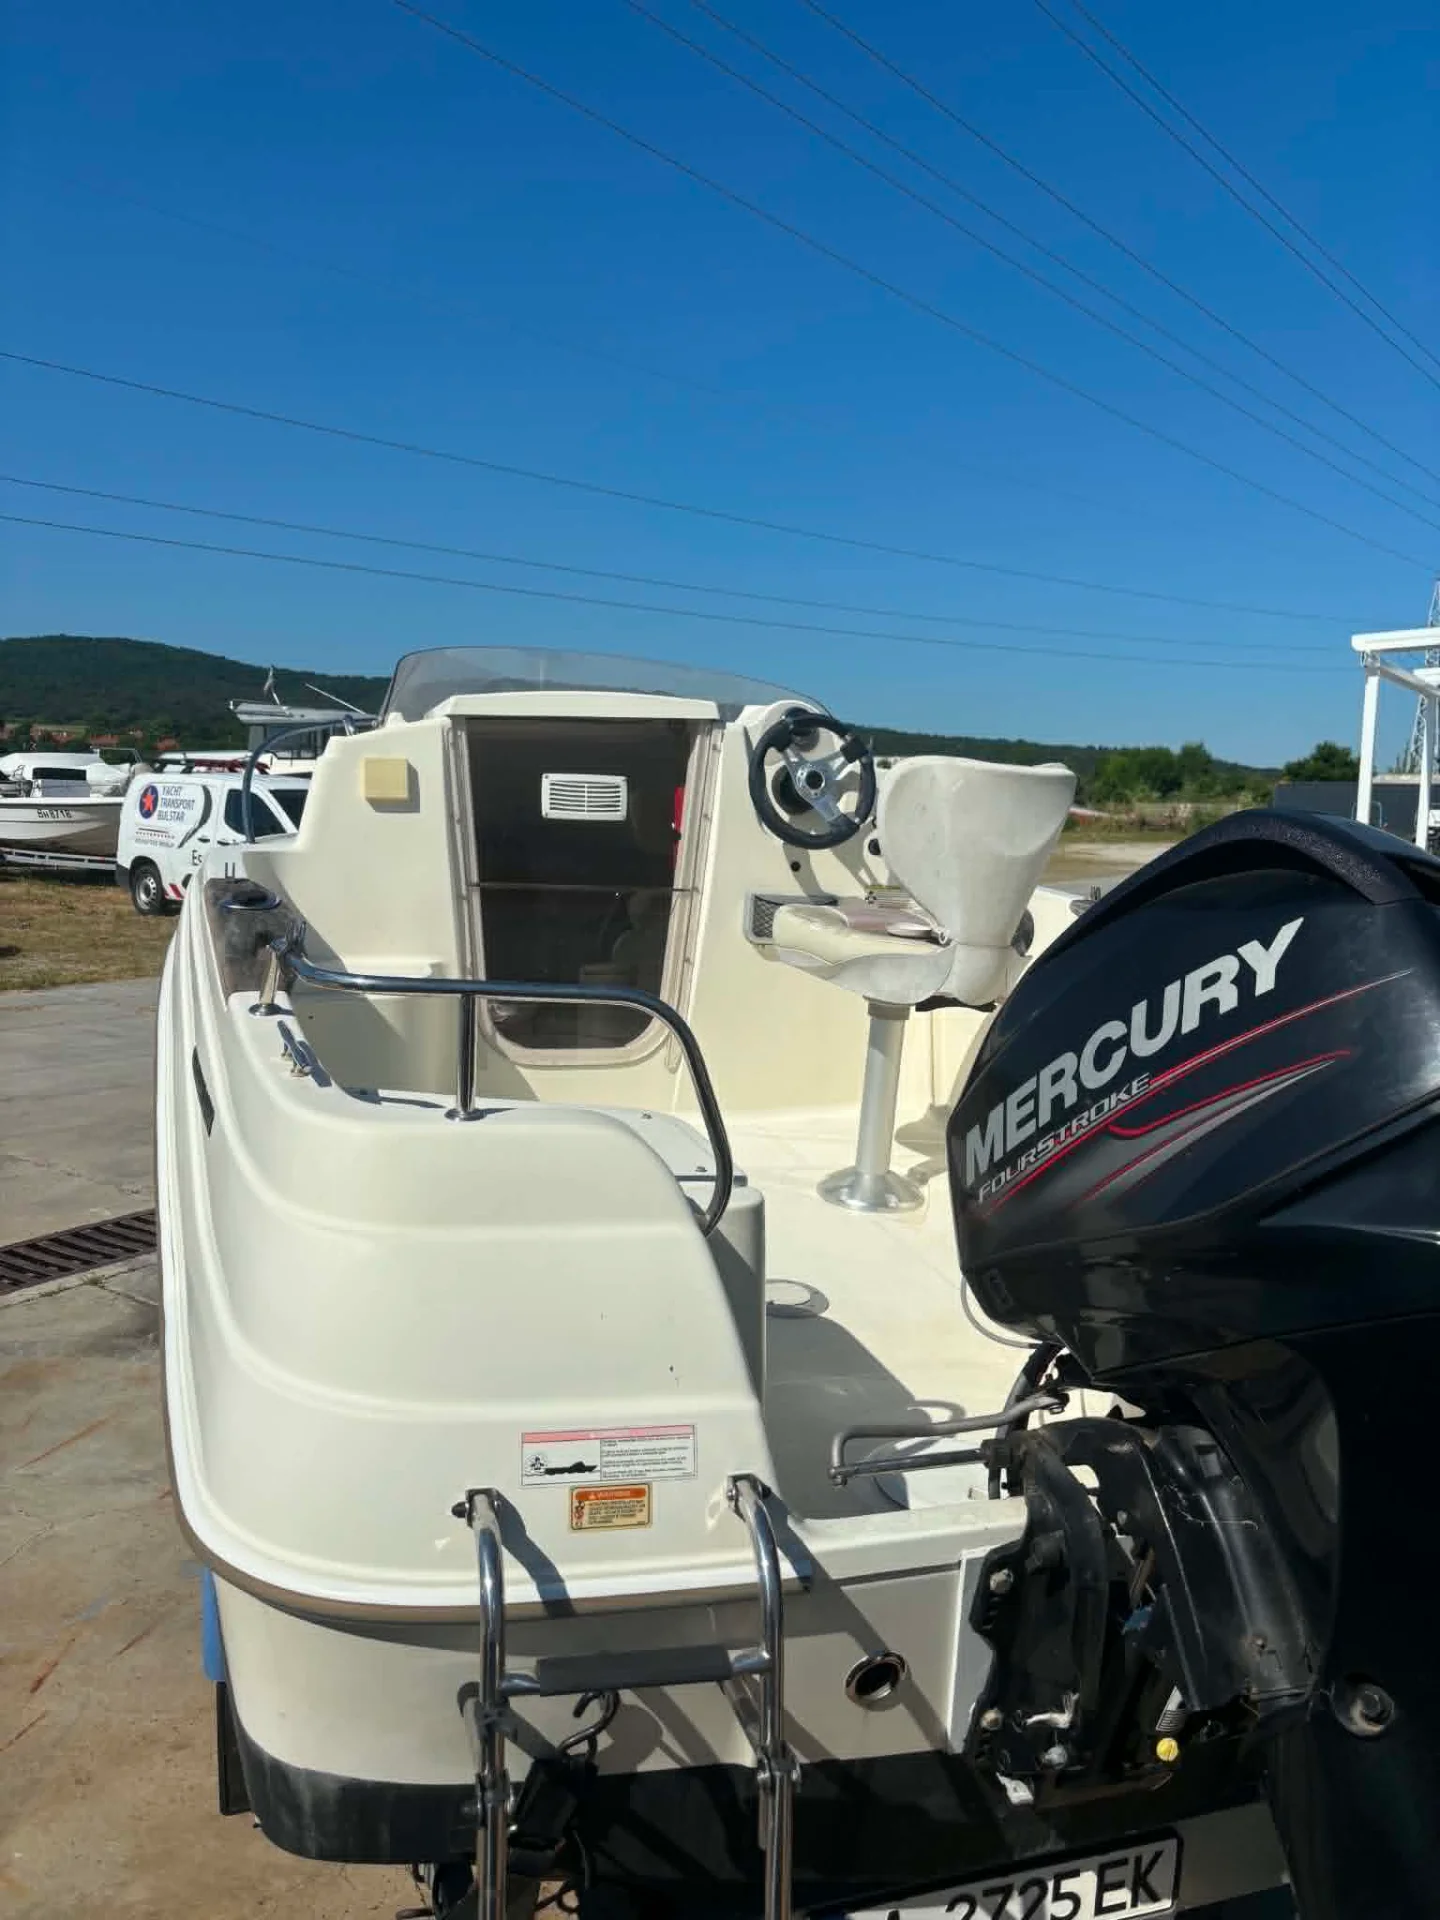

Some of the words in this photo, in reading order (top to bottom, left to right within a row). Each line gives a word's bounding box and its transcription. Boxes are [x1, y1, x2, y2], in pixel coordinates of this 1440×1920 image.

[160, 797, 195, 810] TRANSPORT
[965, 917, 1304, 1187] MERCURY
[978, 1072, 1152, 1202] FOURSTROKE
[1093, 1850, 1164, 1918] EK
